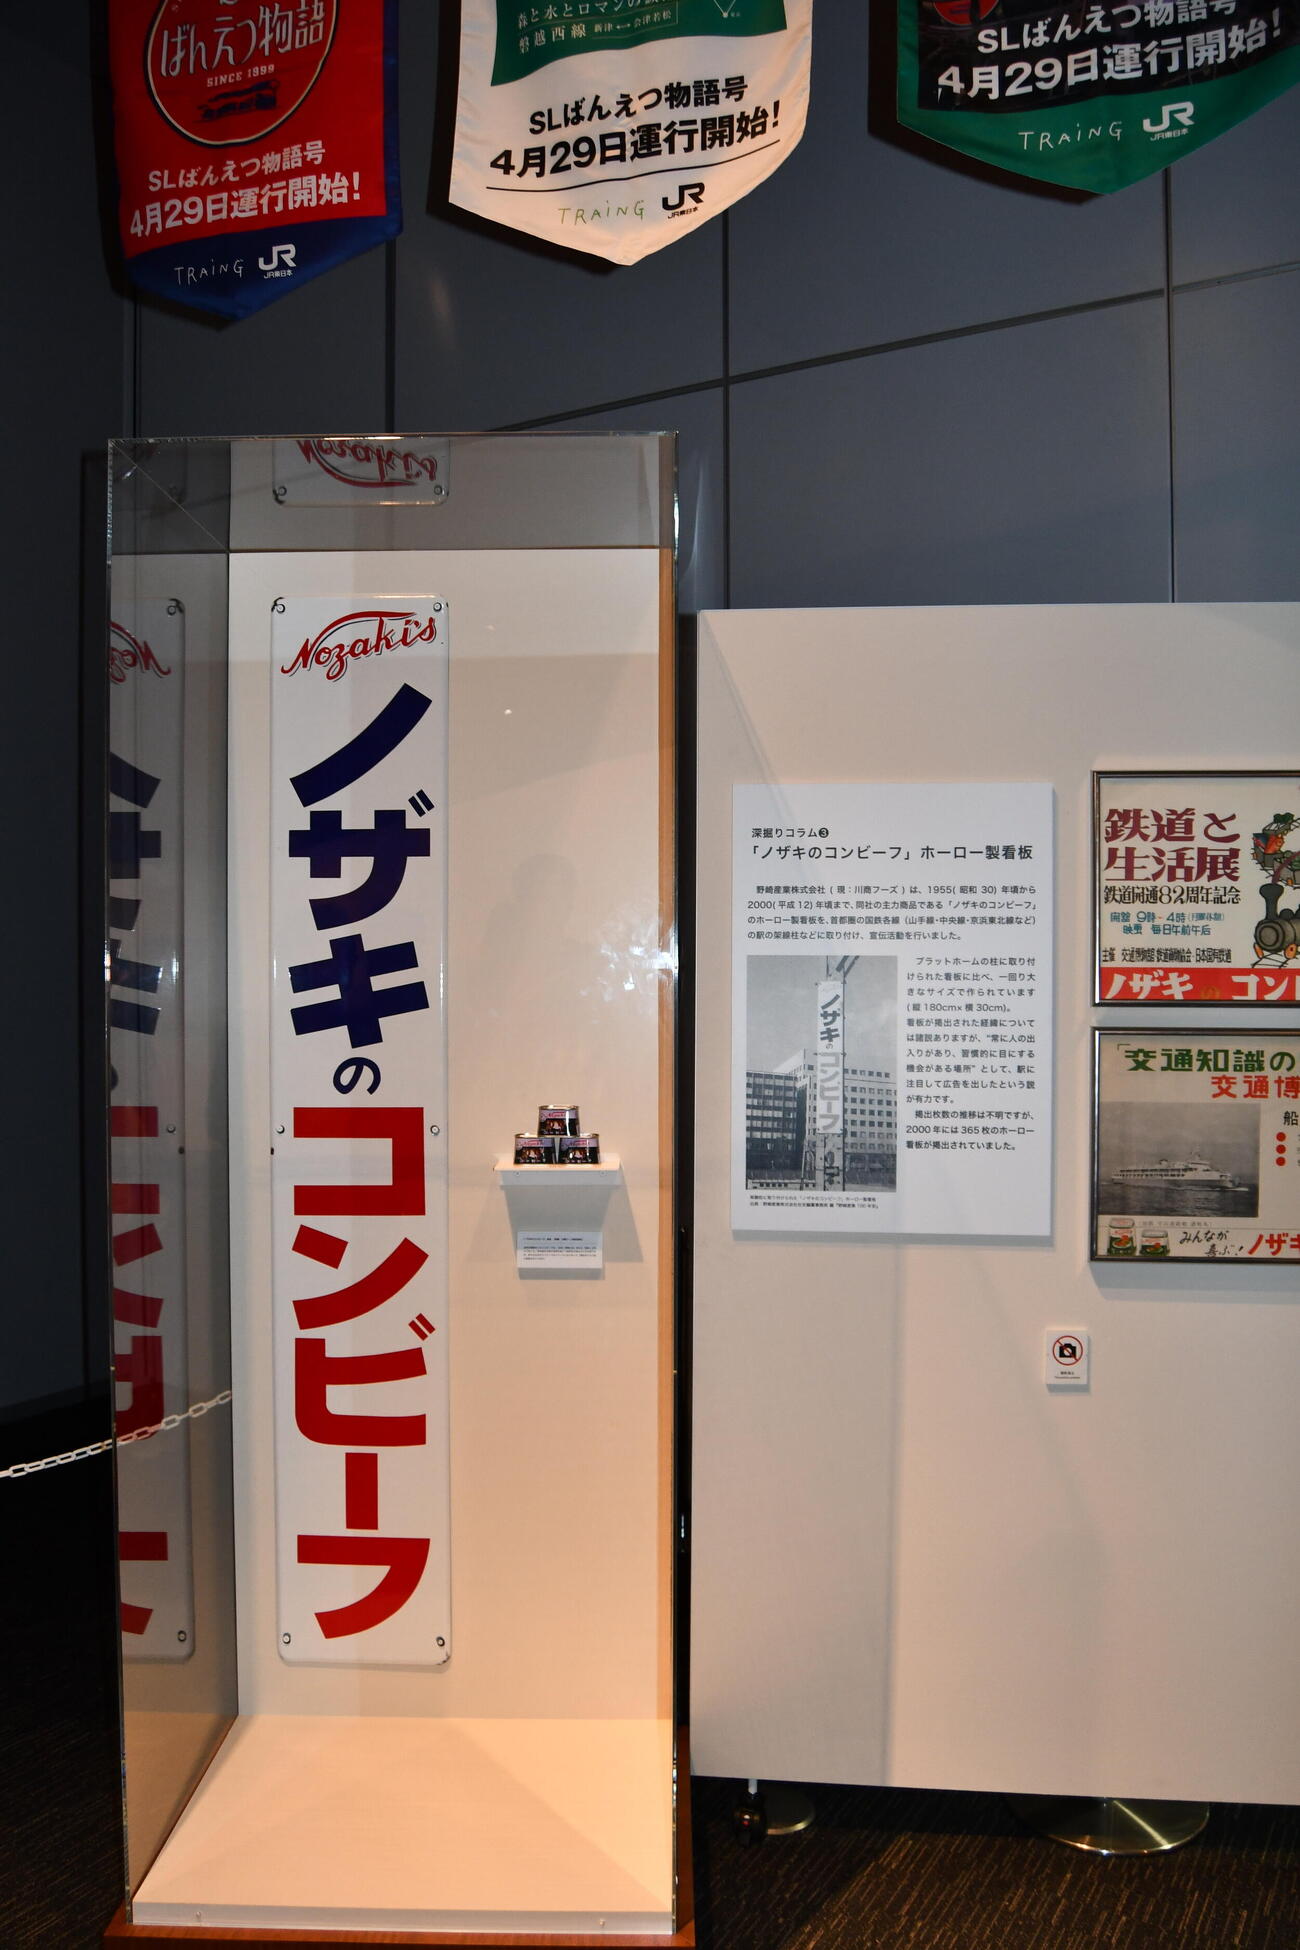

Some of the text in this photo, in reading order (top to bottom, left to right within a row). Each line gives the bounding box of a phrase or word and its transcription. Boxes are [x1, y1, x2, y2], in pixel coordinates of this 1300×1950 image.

[518, 0, 676, 28] 森と水とロマンの
[937, 8, 1282, 100] 4月29日運行開始!
[207, 63, 275, 87] SINCE 1999
[529, 75, 749, 135] SLばんえつ物語号
[1142, 101, 1195, 133] JR
[489, 100, 781, 178] 4月29日運行開始!
[1150, 128, 1189, 142] JR東日本
[148, 140, 326, 192] SLばんえつ物語号
[129, 172, 361, 238] 4月29日運行開始!
[662, 182, 706, 211] JR
[258, 243, 297, 271] JR
[281, 610, 437, 681] Nozaki's
[1104, 808, 1241, 843] 鉄道と
[1104, 847, 1241, 882] 生活展
[1104, 969, 1194, 999] ノザキ
[1231, 974, 1300, 1000] コン
[906, 1095, 955, 1104] が有力です。
[289, 683, 434, 1640] ノザキのコンビーフ
[1179, 1230, 1230, 1244] みんなが
